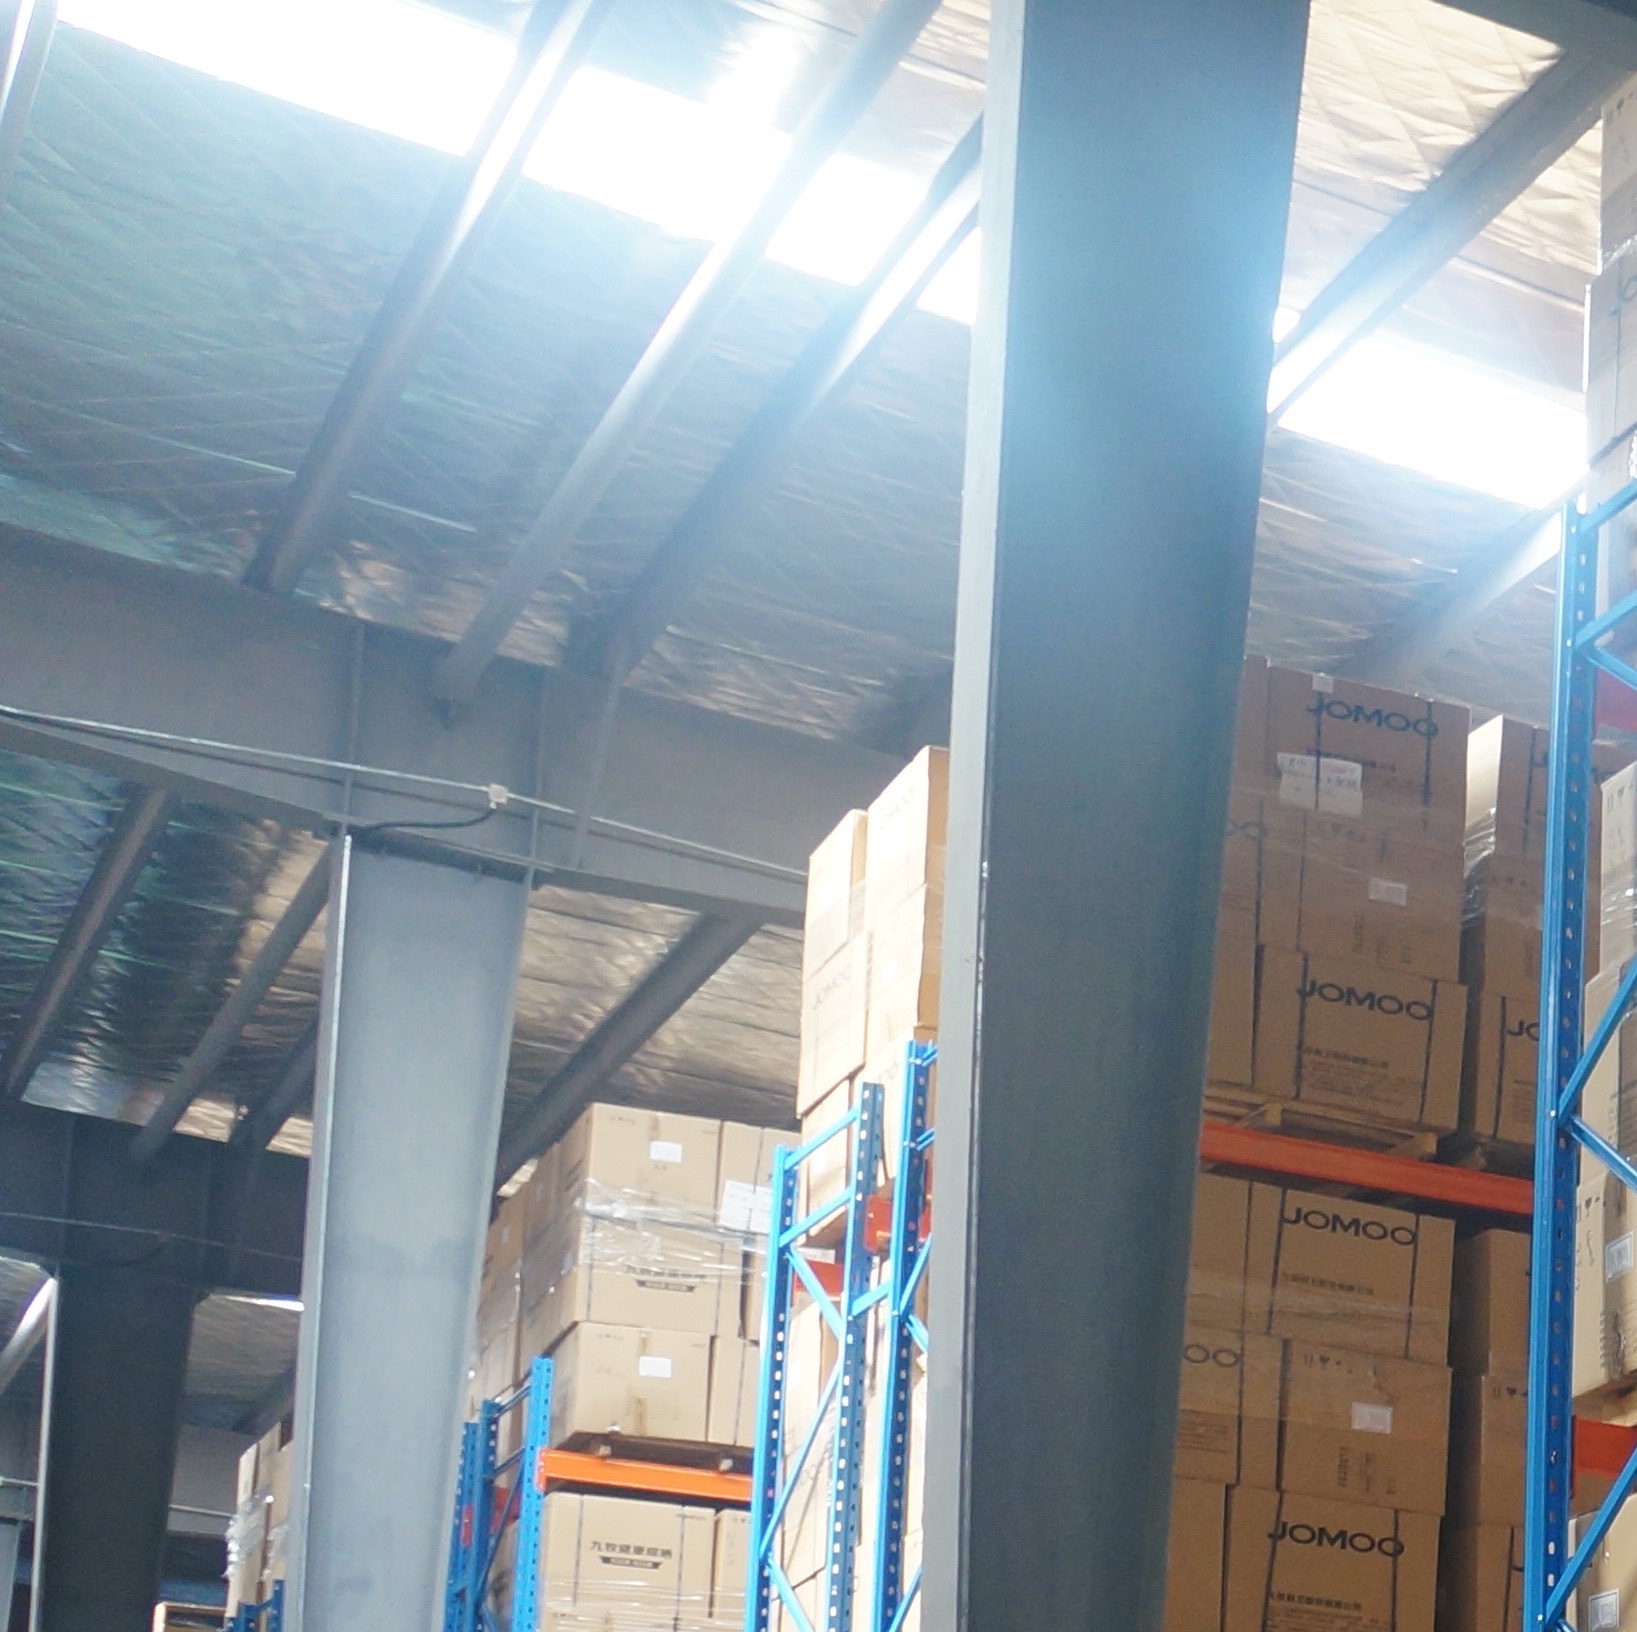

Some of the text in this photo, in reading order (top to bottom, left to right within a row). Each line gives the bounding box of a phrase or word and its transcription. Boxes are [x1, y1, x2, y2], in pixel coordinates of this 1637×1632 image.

[1307, 698, 1438, 737] JOMOO
[1297, 979, 1434, 1022] JOMOO
[1283, 1207, 1419, 1247] JOMOO
[1268, 1522, 1405, 1557] JOMOO
